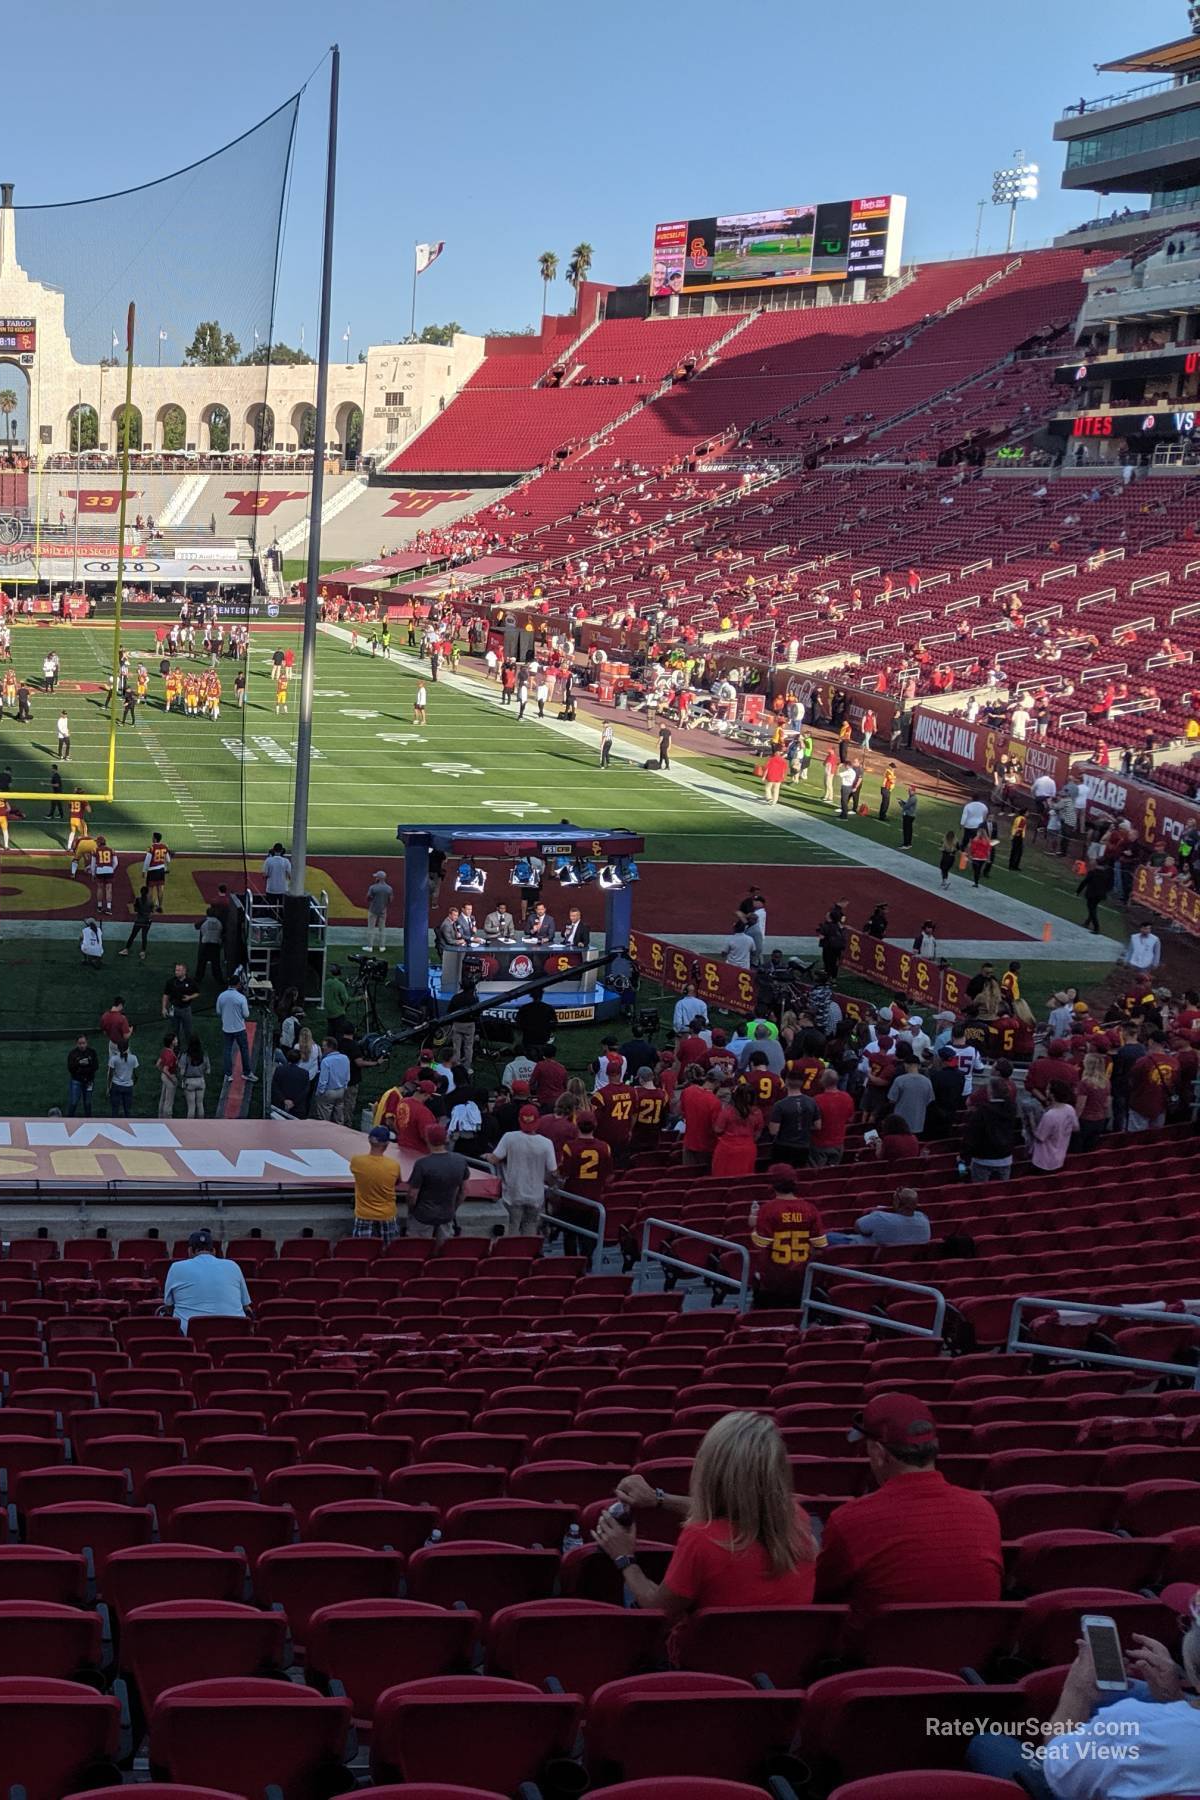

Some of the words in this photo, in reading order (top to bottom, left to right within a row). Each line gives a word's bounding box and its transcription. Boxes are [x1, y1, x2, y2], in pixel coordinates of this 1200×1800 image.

[852, 222, 867, 231] CAL
[850, 239, 870, 248] MISS
[1073, 415, 1112, 436] UTES
[1175, 411, 1195, 431] VS
[85, 496, 113, 507] 33
[88, 548, 120, 556] SECTIO
[249, 607, 260, 615] BY
[915, 714, 953, 752] MUSCLE
[952, 726, 978, 761] MILK
[1025, 746, 1059, 774] CREDIT
[70, 801, 81, 813] 19
[1143, 797, 1157, 843] SC
[97, 851, 110, 864] 18
[591, 841, 601, 856] SC
[651, 943, 663, 970] SC
[850, 934, 860, 961] SC
[875, 944, 886, 971] SC
[673, 953, 687, 981] SC
[704, 963, 719, 991] SC
[900, 954, 910, 981] SC
[916, 962, 930, 990] SC
[738, 972, 753, 1001] SC
[945, 973, 958, 1003] SC
[556, 1008, 593, 1021] FOOTBALL
[1003, 1029, 1014, 1051] 5
[759, 1077, 772, 1099] 9
[802, 1067, 818, 1090] 7
[611, 1100, 632, 1121] 47
[637, 1099, 662, 1124] 21
[579, 1149, 599, 1180] 2
[771, 1231, 810, 1264] 55
